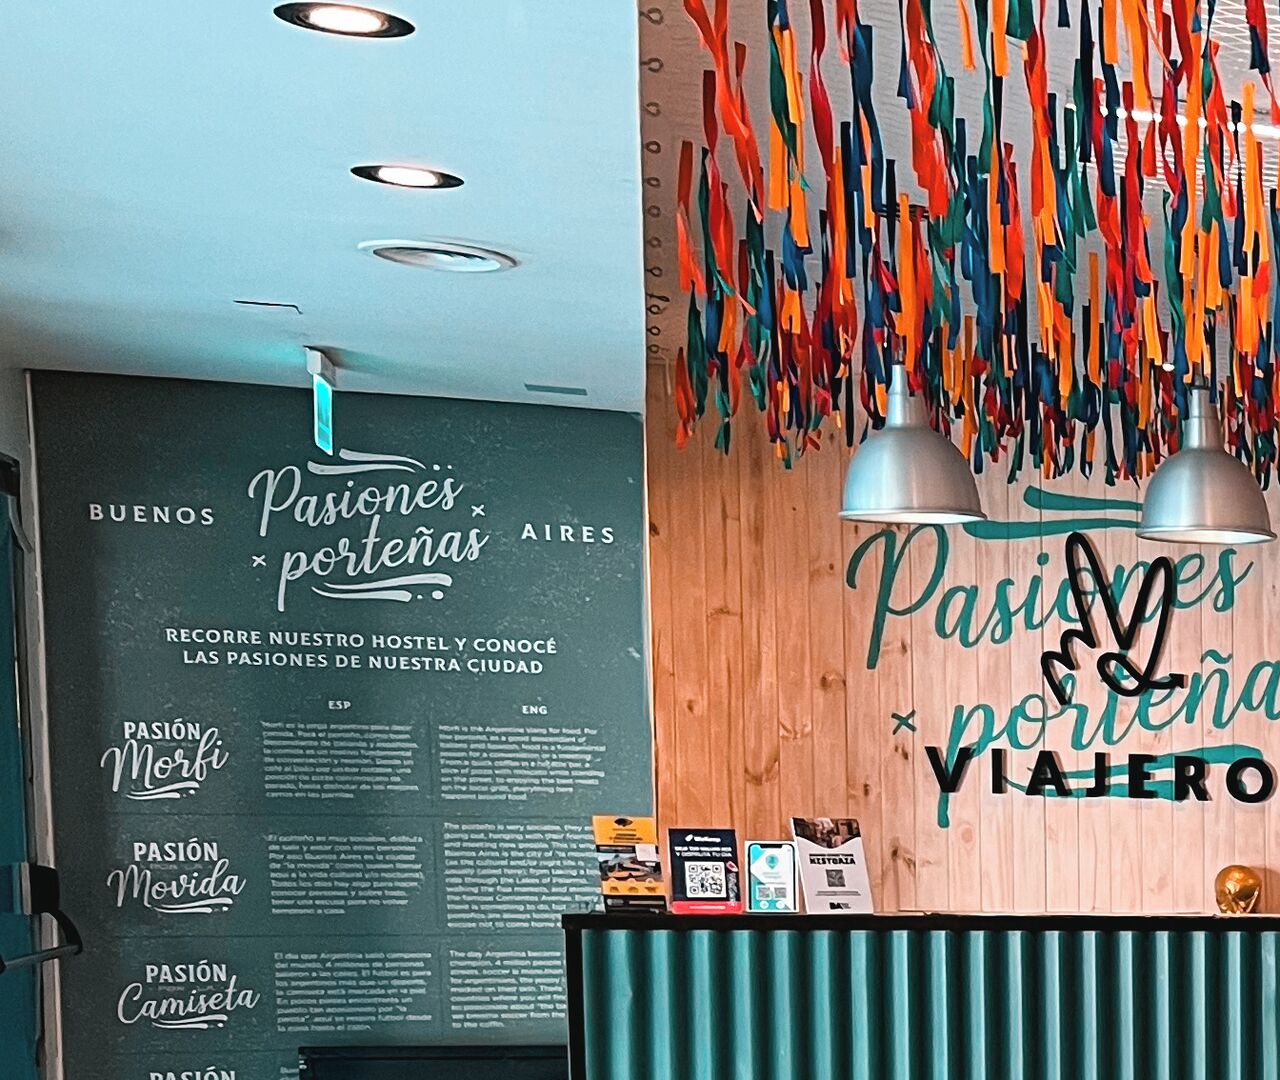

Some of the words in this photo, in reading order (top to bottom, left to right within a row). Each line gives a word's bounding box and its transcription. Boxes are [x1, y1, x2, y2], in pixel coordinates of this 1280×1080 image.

[248, 461, 463, 537] Pasiones
[90, 504, 214, 525] BUENOS
[522, 524, 615, 543] AIRES
[278, 514, 489, 612] porteñas
[846, 525, 1254, 669] Pasiones
[166, 628, 262, 645] RECORRE
[269, 631, 365, 649] NUESTRO
[372, 635, 448, 651] HOSTEL
[454, 637, 466, 652] Y
[473, 636, 557, 654] CONOCÉ
[183, 651, 221, 665] LAS
[227, 650, 328, 669] PASIONES
[336, 654, 362, 669] DE
[368, 655, 461, 672] NUESTRA
[466, 658, 543, 674] CIUDAD
[328, 700, 351, 709] ESP
[522, 705, 548, 715] ENG
[123, 718, 200, 740] PASIÓN
[100, 728, 229, 792] Morfi
[924, 746, 1278, 803] VIAJERO
[133, 838, 218, 862] PASIÓN
[106, 859, 246, 911] Movida
[146, 960, 227, 983] PASIÓN
[117, 975, 260, 1024] Camiseta
